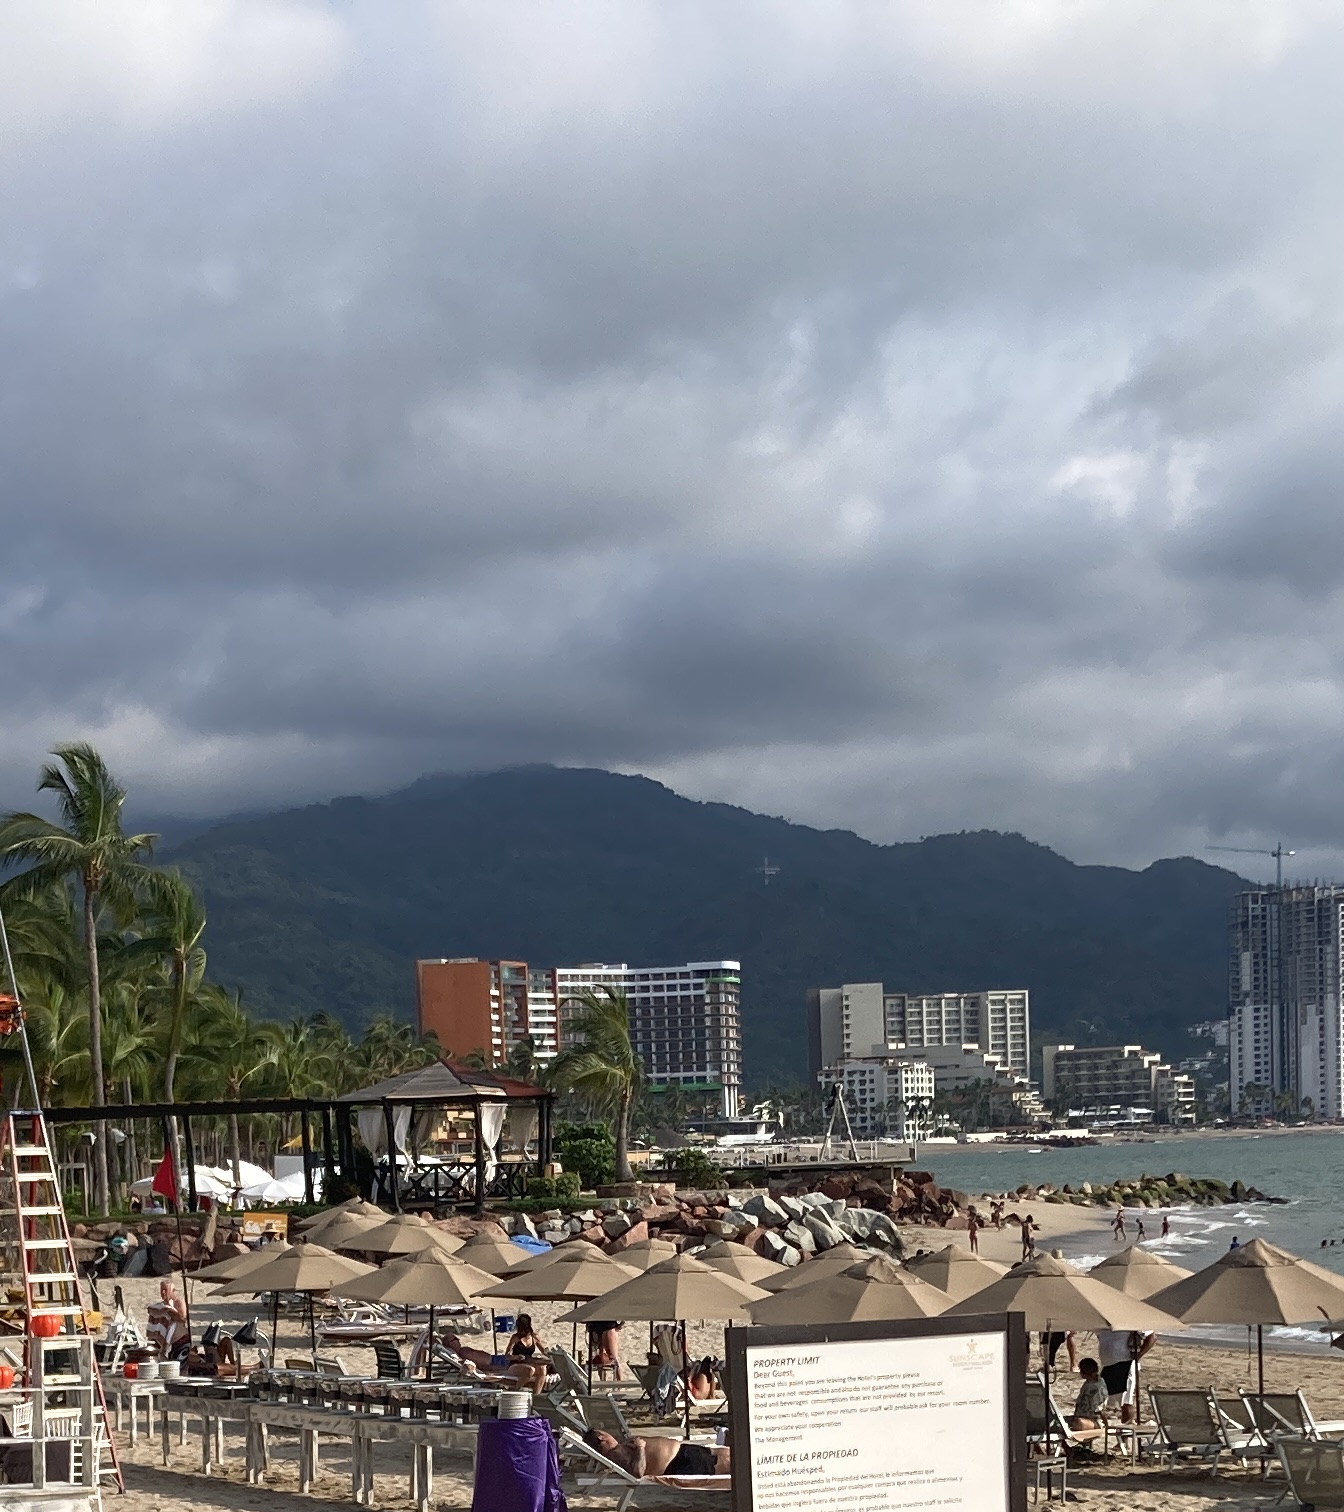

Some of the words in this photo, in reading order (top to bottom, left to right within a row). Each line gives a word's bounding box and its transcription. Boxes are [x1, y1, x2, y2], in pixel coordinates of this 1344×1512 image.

[754, 1358, 796, 1368] PROPERTY
[797, 1356, 820, 1365] LIMIT
[754, 1371, 770, 1379] Dear
[772, 1369, 795, 1378] Guest,
[877, 1374, 901, 1382] property
[798, 1388, 829, 1396] responsible
[872, 1383, 899, 1392] guarantee
[912, 1381, 936, 1389] purchase
[883, 1392, 907, 1400] provided
[765, 1424, 794, 1432] appreciate
[809, 1421, 841, 1429] cooperation
[766, 1434, 803, 1443] Management
[757, 1454, 784, 1466] LÍMITE
[786, 1453, 797, 1463] DE
[799, 1452, 809, 1462] LA
[811, 1448, 859, 1460] PROPIEDAD
[757, 1468, 790, 1479] Estimado
[791, 1465, 825, 1476] Huésped,
[787, 1478, 824, 1487] abandonando
[832, 1475, 859, 1483] Propiedad
[801, 1486, 836, 1495] responsables
[859, 1492, 889, 1501] propiedad.
[866, 1503, 890, 1512] probable
